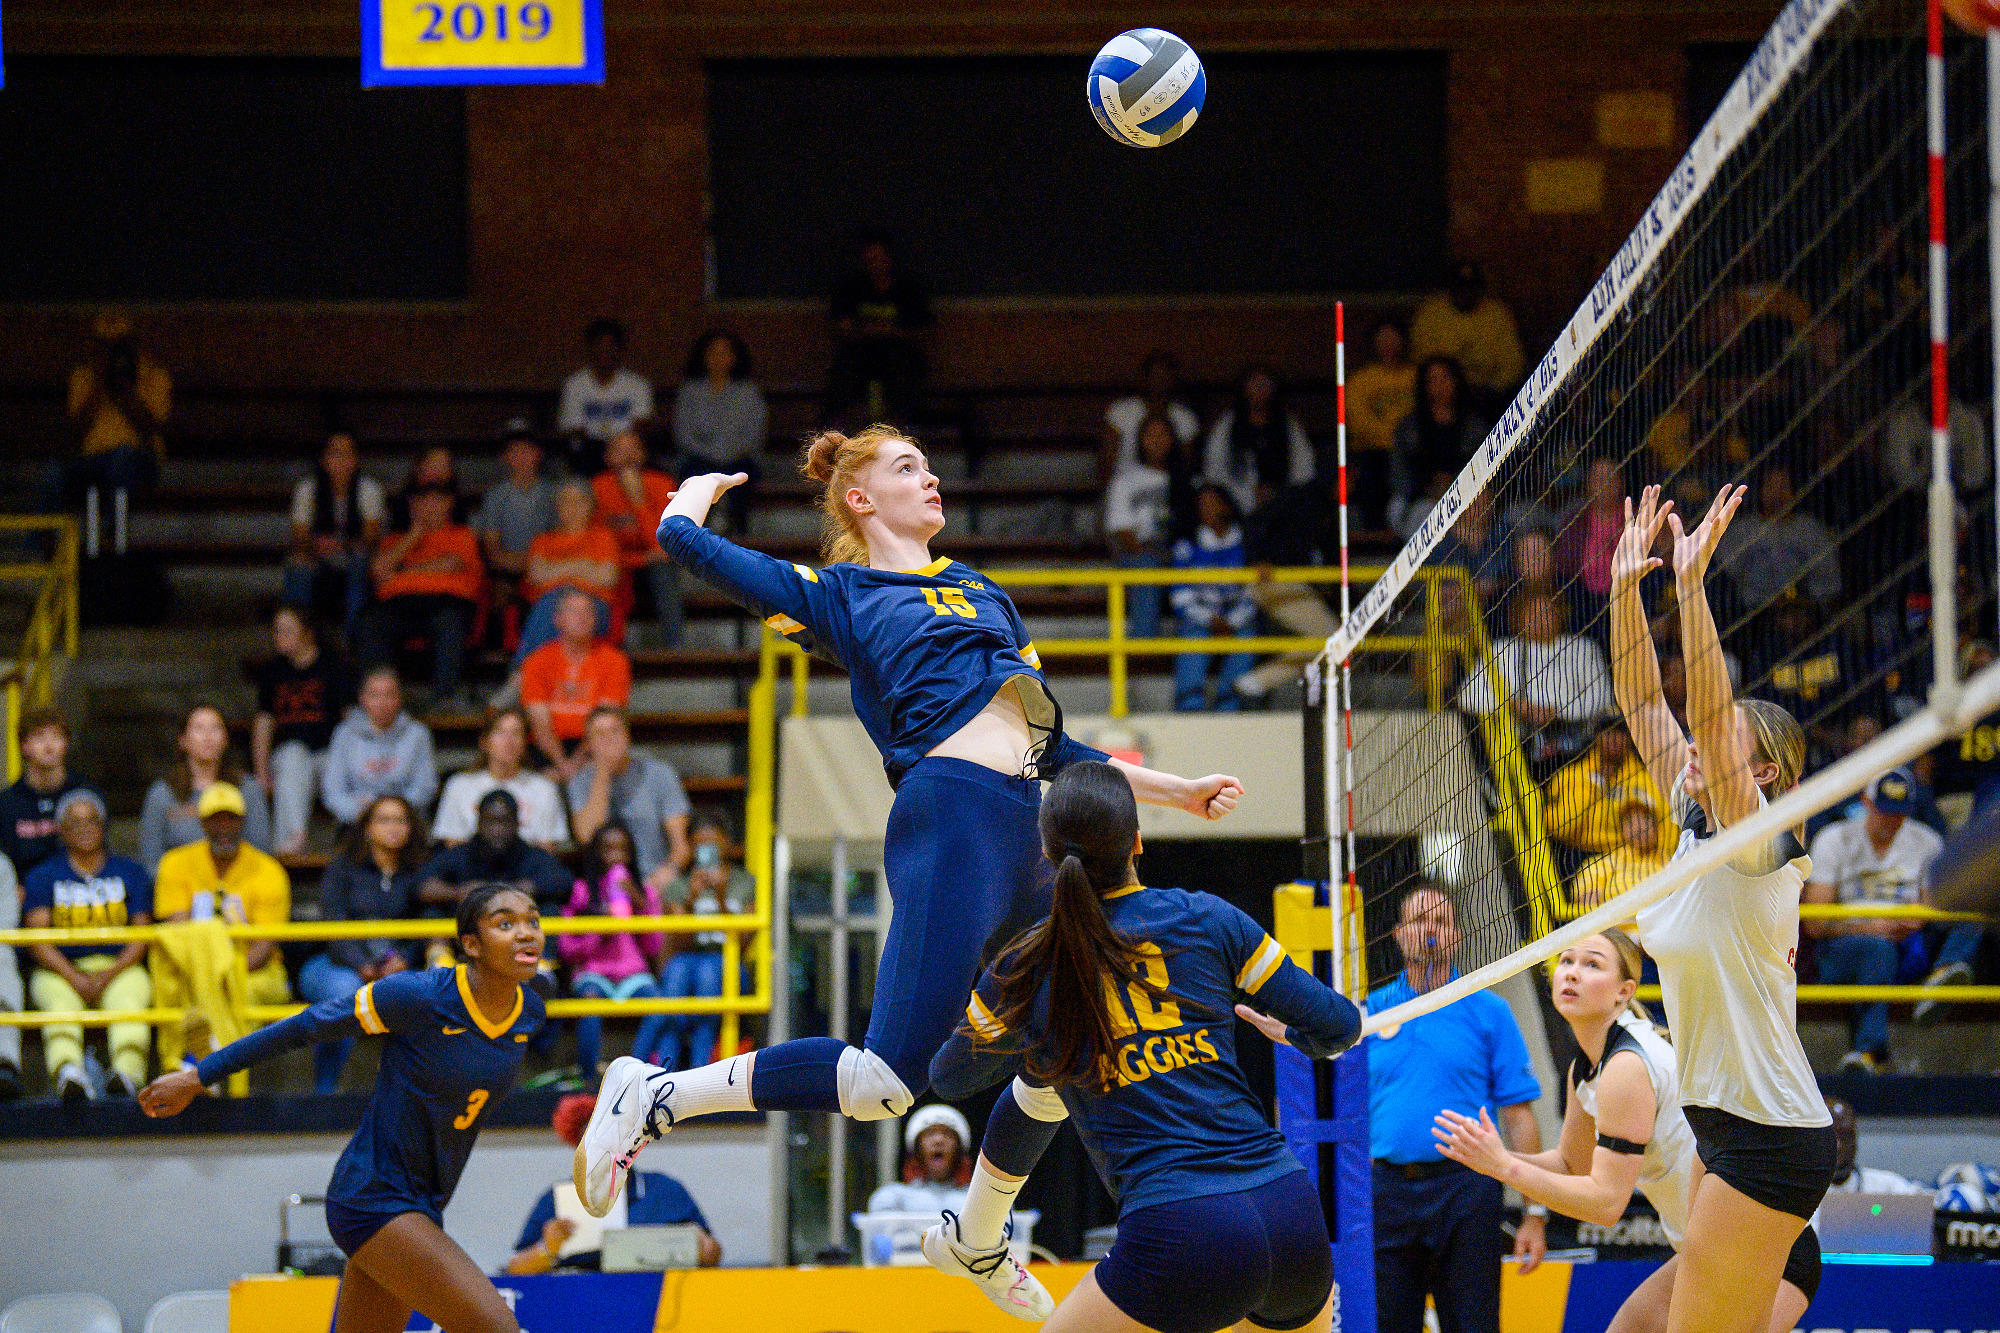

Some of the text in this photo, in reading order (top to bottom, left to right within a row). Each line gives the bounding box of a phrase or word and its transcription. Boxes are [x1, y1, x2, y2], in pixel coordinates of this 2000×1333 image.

[413, 2, 554, 43] 2019
[920, 586, 978, 619] 15
[1100, 941, 1184, 1040] 12
[453, 1089, 490, 1130] 3
